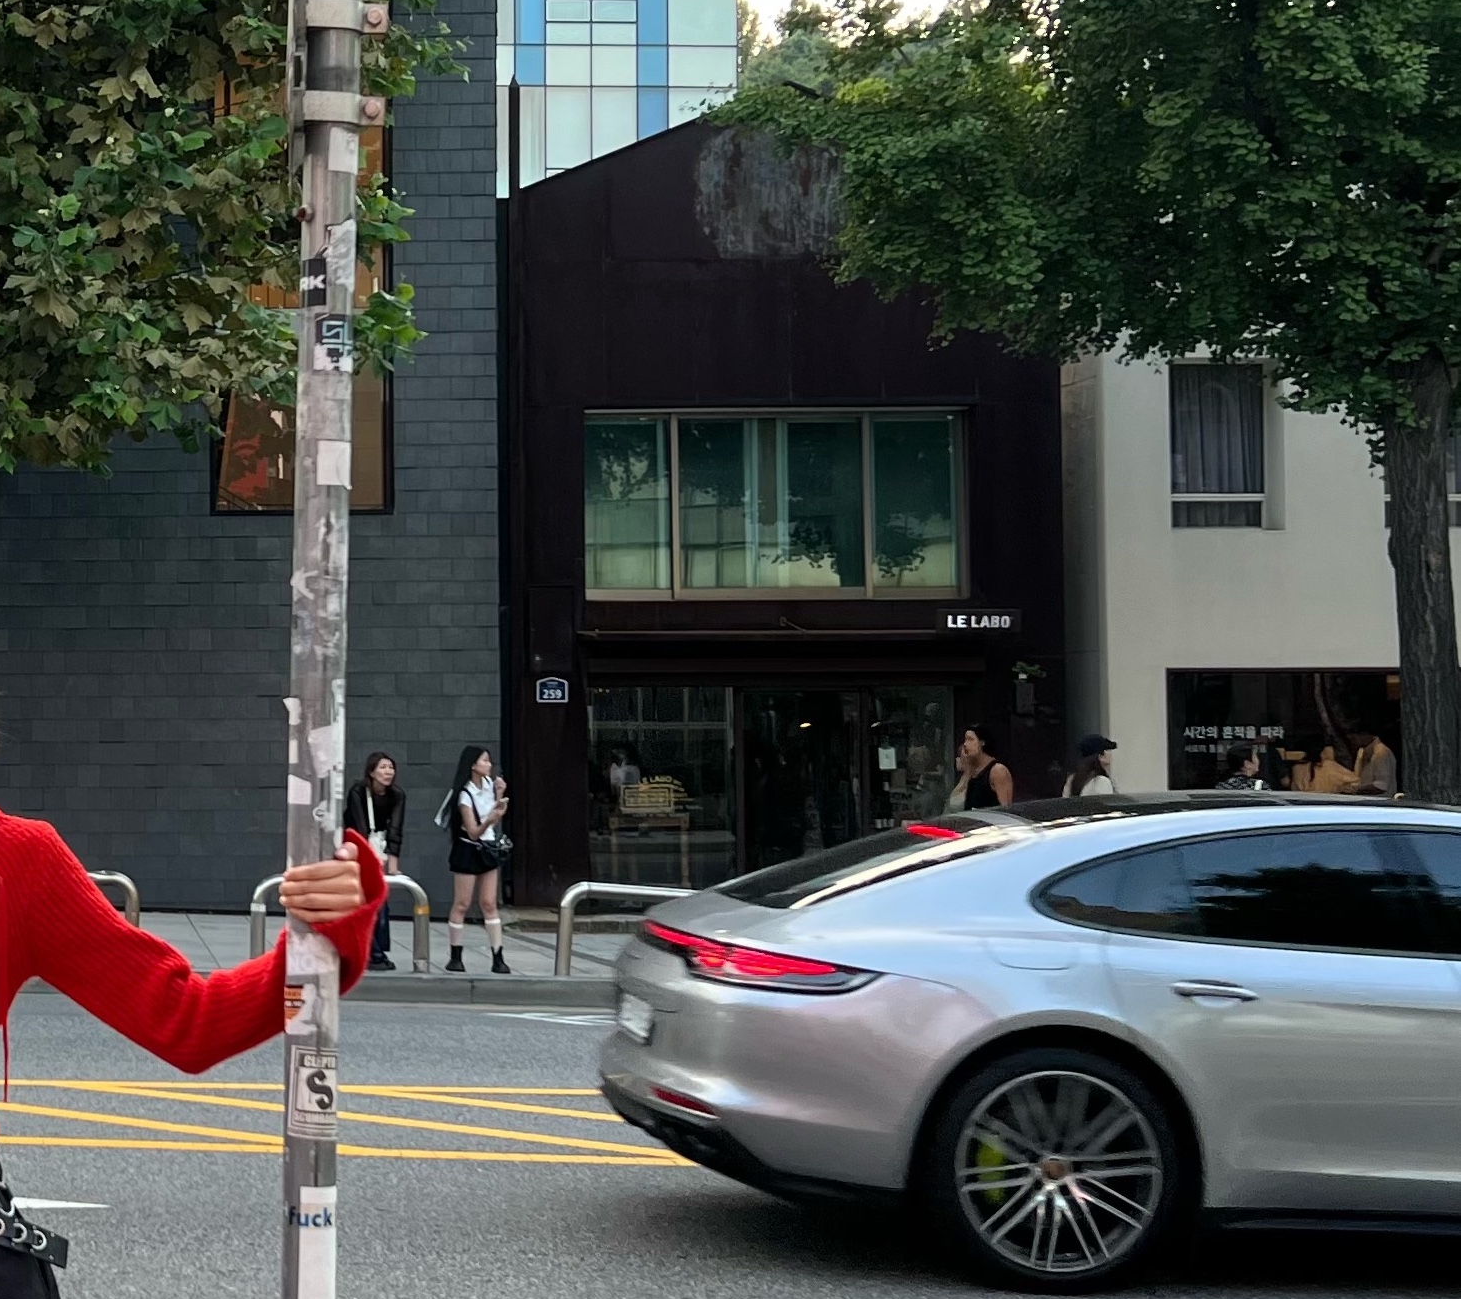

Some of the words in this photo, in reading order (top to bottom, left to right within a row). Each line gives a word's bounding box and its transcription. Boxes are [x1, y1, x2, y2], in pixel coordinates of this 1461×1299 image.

[946, 614, 968, 628] LE
[970, 615, 1012, 628] LABO
[542, 689, 562, 699] 259
[1183, 725, 1218, 739] 시간의
[1222, 726, 1256, 739] 흔적을
[1260, 726, 1285, 739] 따라
[289, 1205, 332, 1227] fuck
